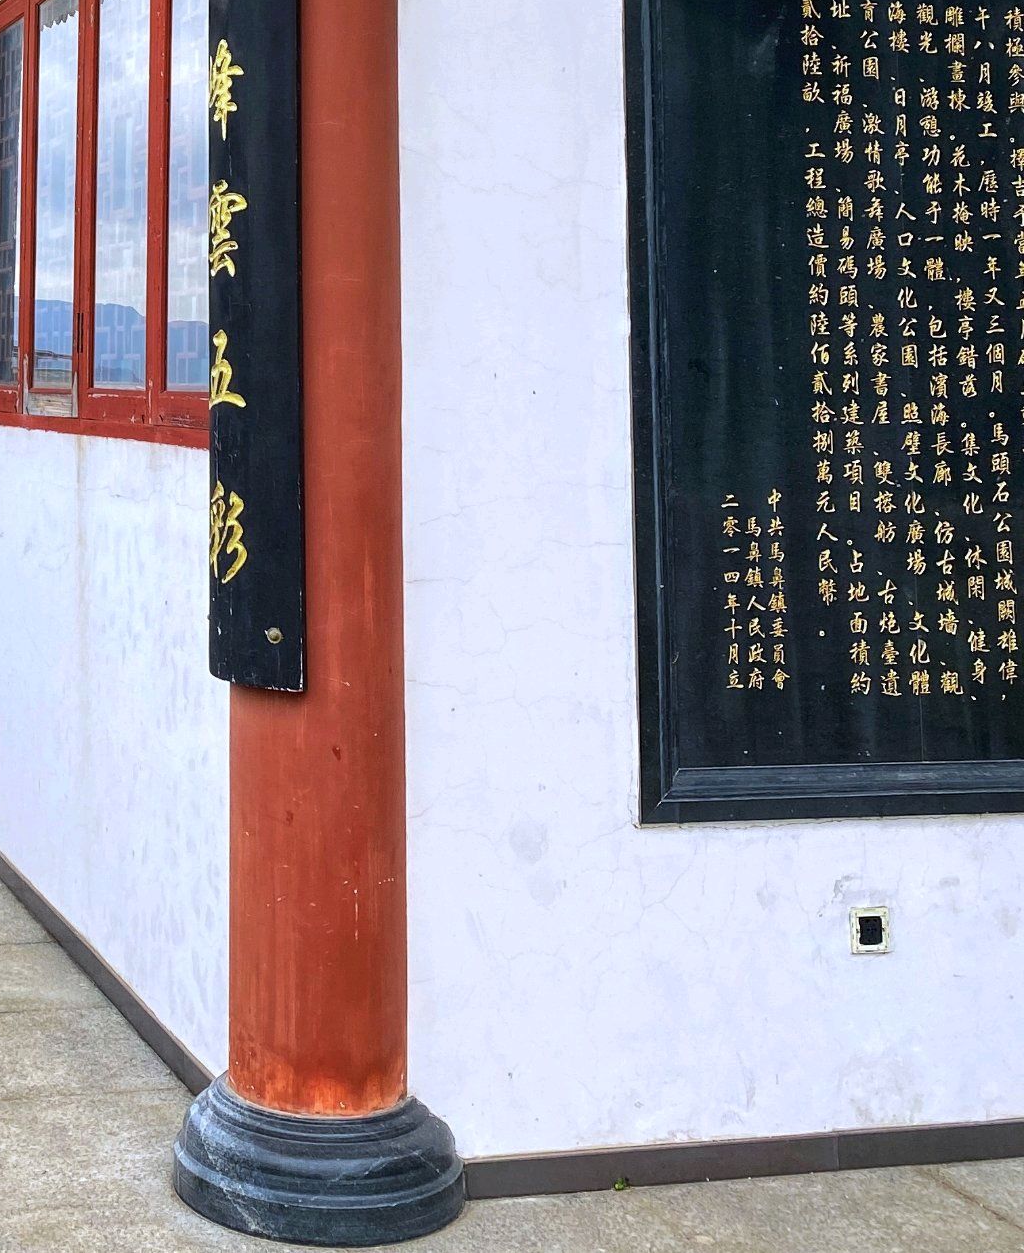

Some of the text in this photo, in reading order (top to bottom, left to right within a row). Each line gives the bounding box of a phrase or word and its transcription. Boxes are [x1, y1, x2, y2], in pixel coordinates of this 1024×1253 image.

[721, 494, 745, 689] 二零一四年十月立
[745, 516, 767, 691] 馬鼻鎮人民政府
[767, 488, 791, 691] 中共馬鼻鎮委員會
